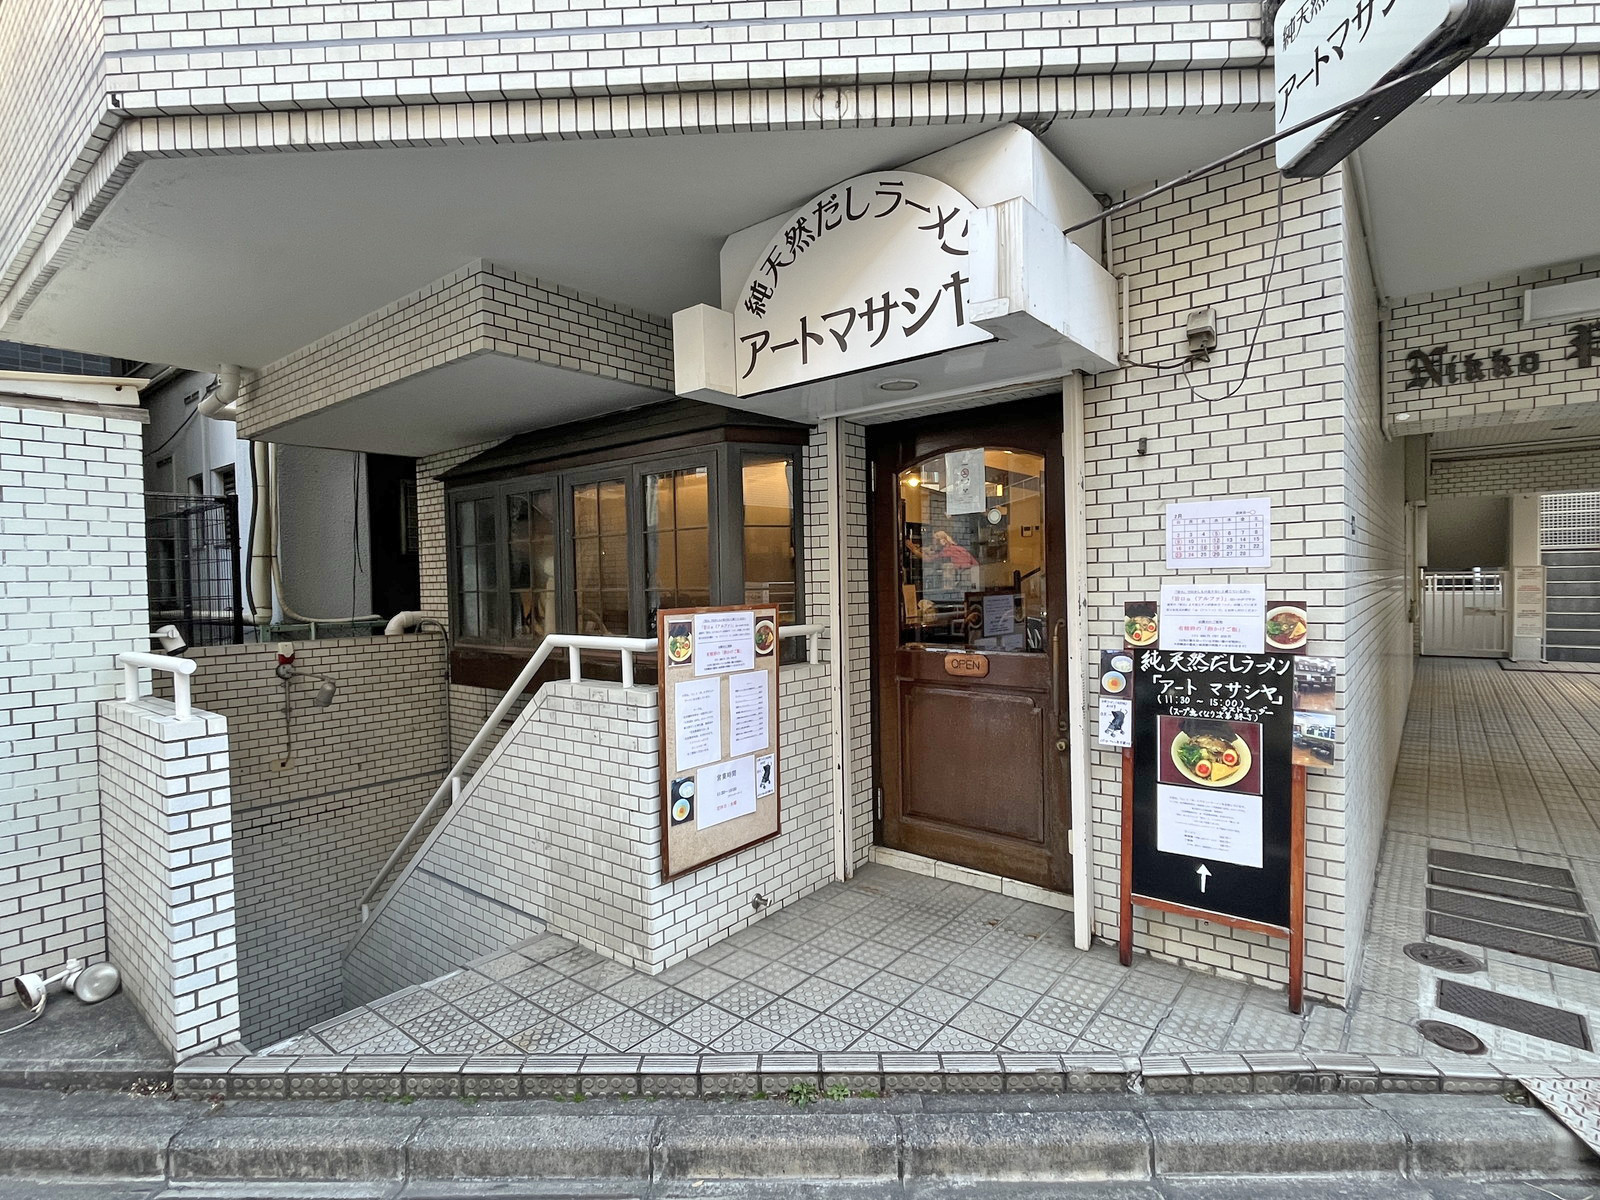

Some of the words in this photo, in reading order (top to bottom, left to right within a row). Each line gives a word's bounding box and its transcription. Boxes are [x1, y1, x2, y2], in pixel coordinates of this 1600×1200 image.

[1406, 344, 1539, 390] Nikko
[951, 659, 980, 670] OPEN
[1140, 651, 1291, 676] 純天然だしラーメン
[1152, 674, 1198, 696] 「アート
[716, 769, 737, 781] 営業時間
